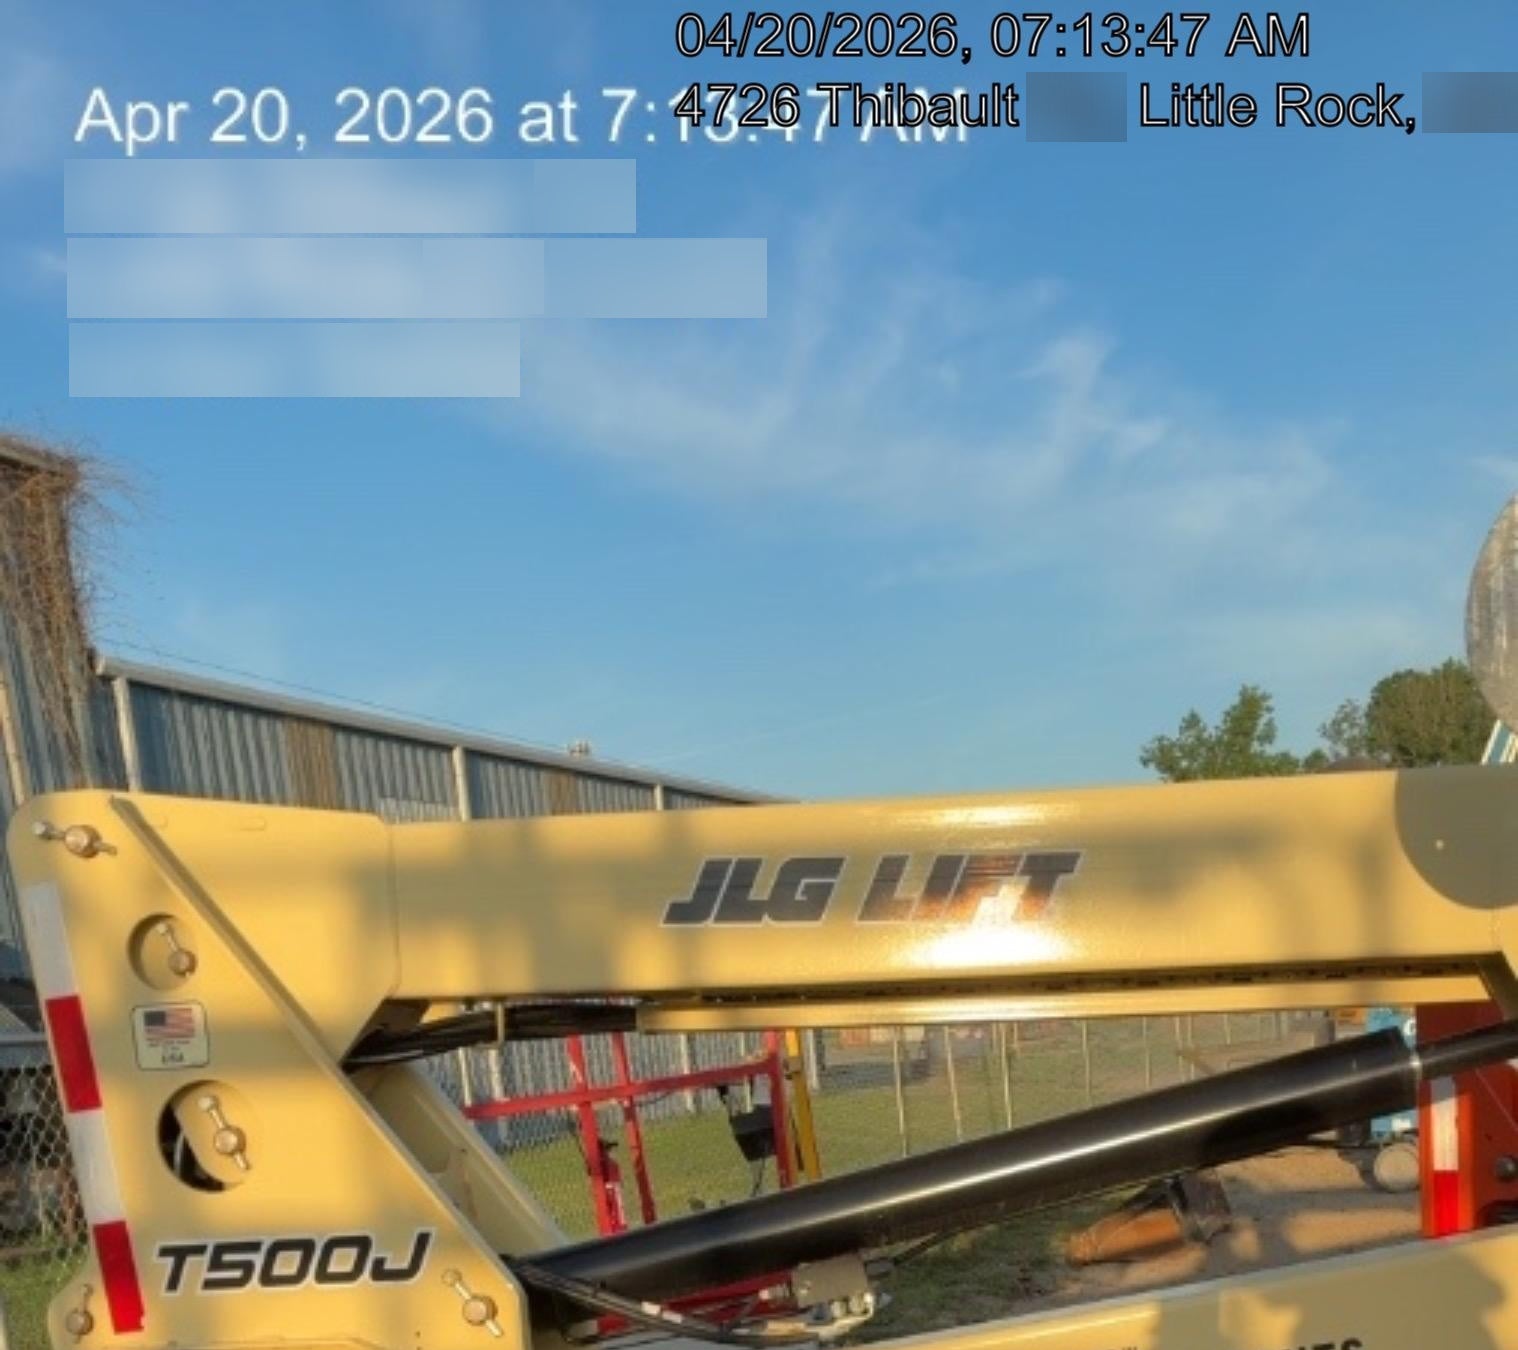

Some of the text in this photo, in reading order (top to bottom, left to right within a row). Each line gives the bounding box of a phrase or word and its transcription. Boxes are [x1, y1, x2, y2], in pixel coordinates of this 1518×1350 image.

[660, 852, 1083, 926] JLG LIFT
[156, 1229, 434, 1295] T500J
